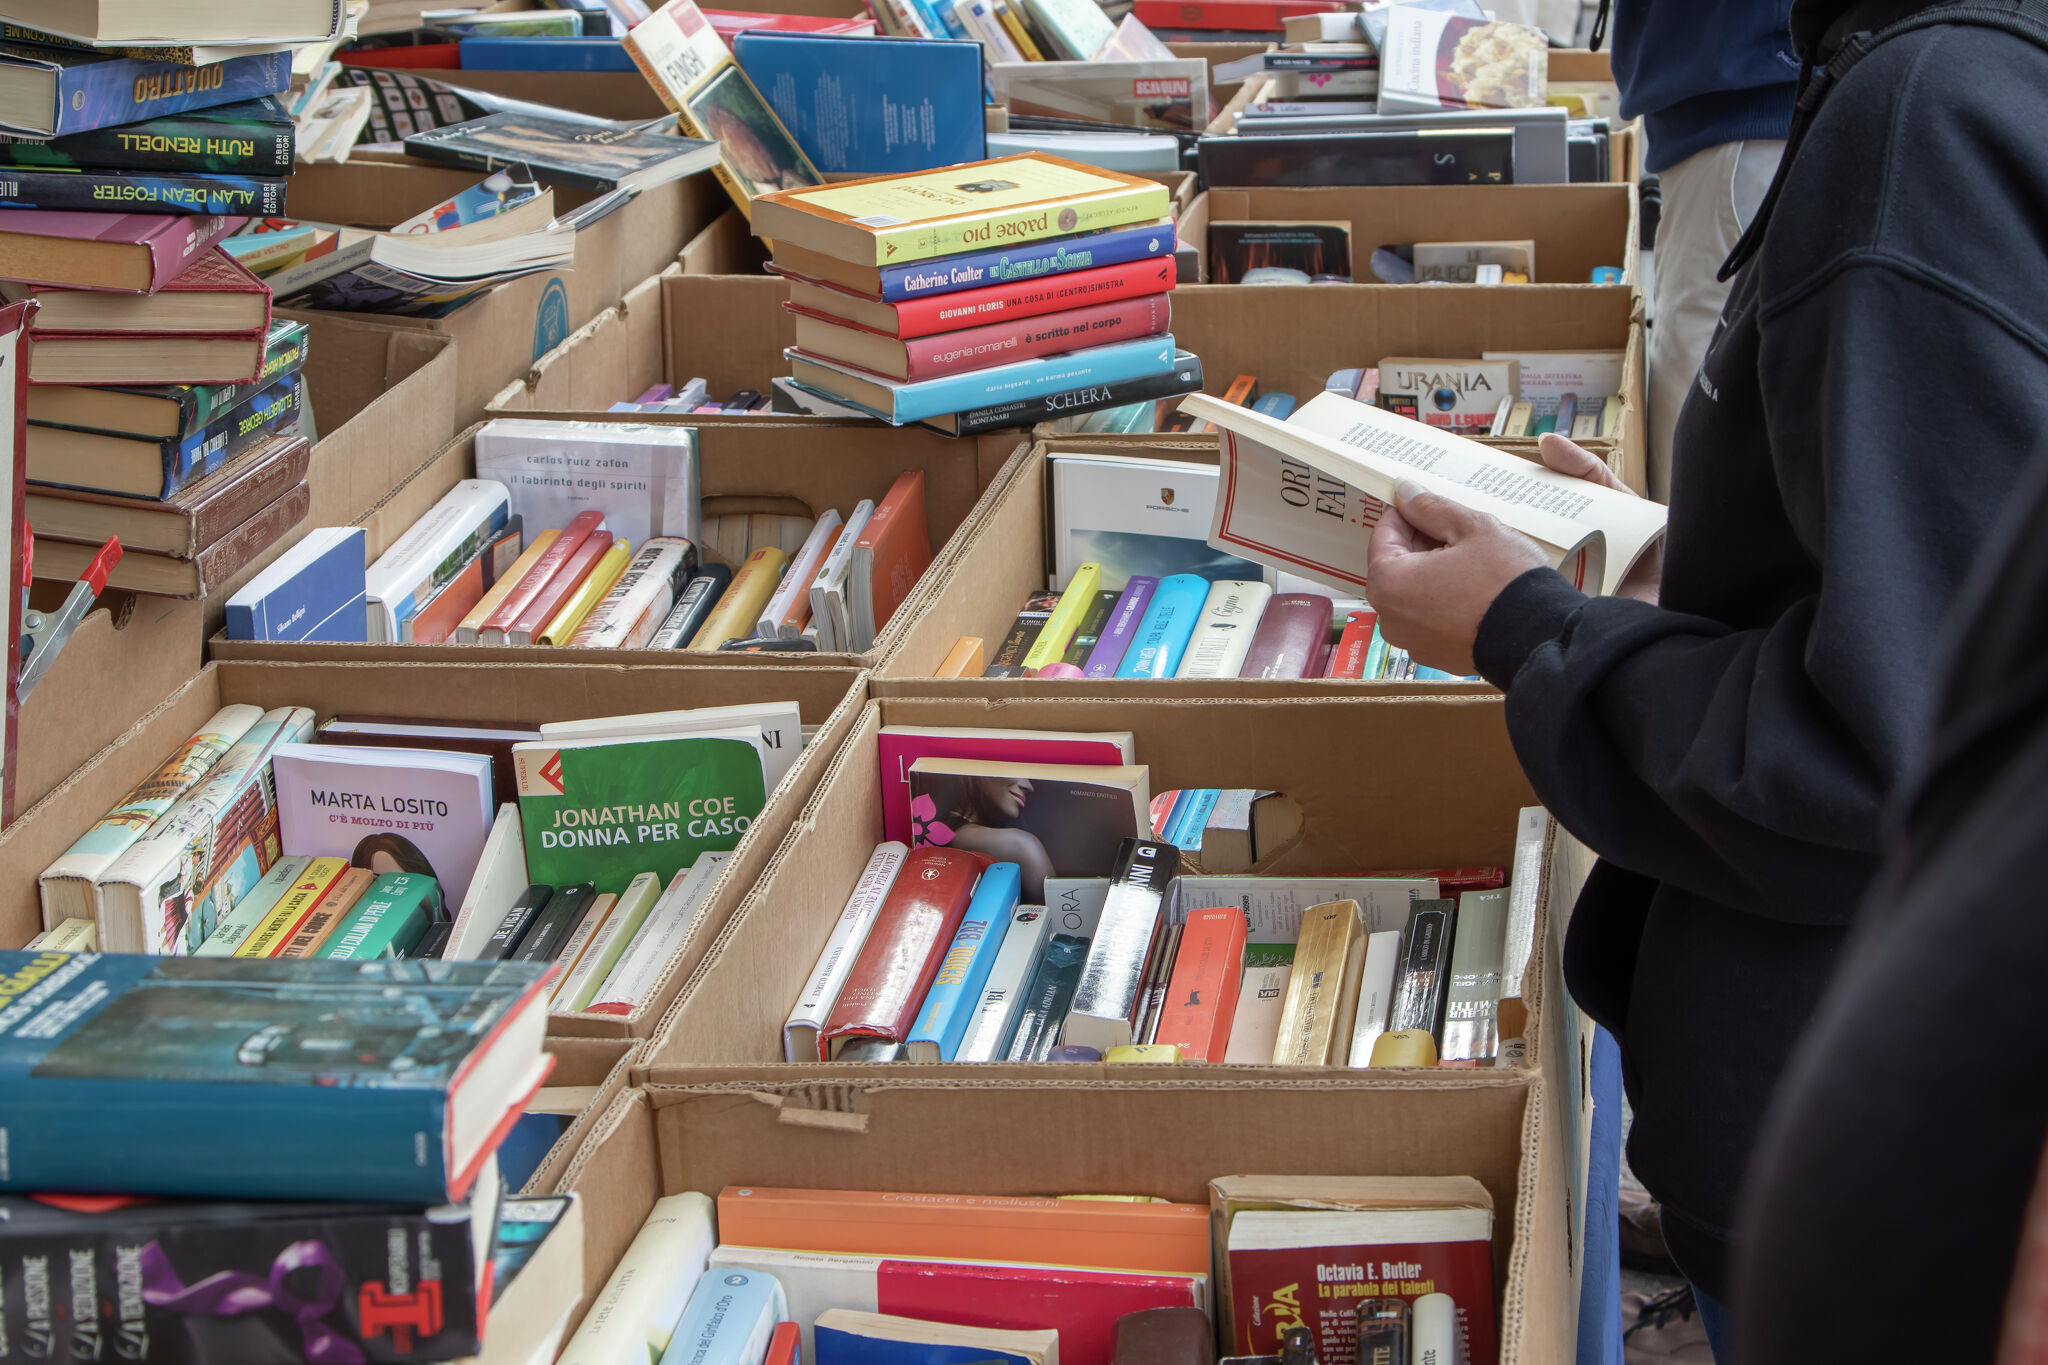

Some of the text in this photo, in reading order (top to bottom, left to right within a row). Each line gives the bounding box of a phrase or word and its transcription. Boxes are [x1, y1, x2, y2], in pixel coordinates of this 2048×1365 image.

[5, 25, 20, 38] ME
[133, 63, 223, 104] QUATTRO
[1135, 79, 1189, 97] SCAVOLINI
[117, 133, 255, 156] RUTH RENDELL
[275, 134, 283, 165] FABBRI
[282, 135, 290, 165] EDITORI
[0, 181, 19, 197] ALIE
[93, 184, 255, 205] ALAN DEAN FOSTER
[262, 183, 270, 214] FABBRI
[269, 183, 277, 214] EDITORI
[963, 212, 1048, 245] padre pio
[904, 267, 949, 292] Catherine
[951, 265, 984, 285] Coulter
[939, 279, 1125, 320] GIOVANNI FLORIS UNA COSA DI (CENTRO)SINISTRA
[932, 315, 1123, 365] eugenia romanelli è scritto nel corpo
[262, 360, 279, 380] HIGHS
[985, 367, 1092, 393] daria bignardi un karma pesante
[1396, 370, 1493, 400] URANIA
[968, 401, 1027, 419] DANILA COMASTRI
[1044, 385, 1113, 413] SCELERA
[238, 393, 293, 438] ELIZABETH GEORGE
[969, 412, 1011, 426] MONTANARI
[526, 455, 629, 469] carlos ruiz zafón
[510, 475, 647, 491] il labirinto degli spiriti
[1280, 457, 1311, 509] ORI
[1145, 504, 1190, 513] PORSCHE
[1211, 595, 1245, 618] Cigno
[310, 788, 449, 818] MARTA LOSITO
[552, 796, 736, 829] JONATHAN COE
[349, 815, 391, 828] MOLTO
[393, 818, 410, 831] DI
[412, 818, 435, 832] PIÙ
[541, 815, 752, 849] DONNA PER CASO
[870, 850, 888, 873] DELLA
[877, 851, 900, 887] PIEMONTE
[492, 907, 527, 941] DE VIGAN
[812, 974, 828, 998] ENRICO
[881, 1192, 1062, 1209] Crostacei e molluschi
[22, 1254, 50, 1316] PASSIONE
[68, 1247, 96, 1315] SEDUZIONE
[1316, 1260, 1423, 1283] Octavia E. Butler
[1318, 1279, 1436, 1300] La parabola dei talenti
